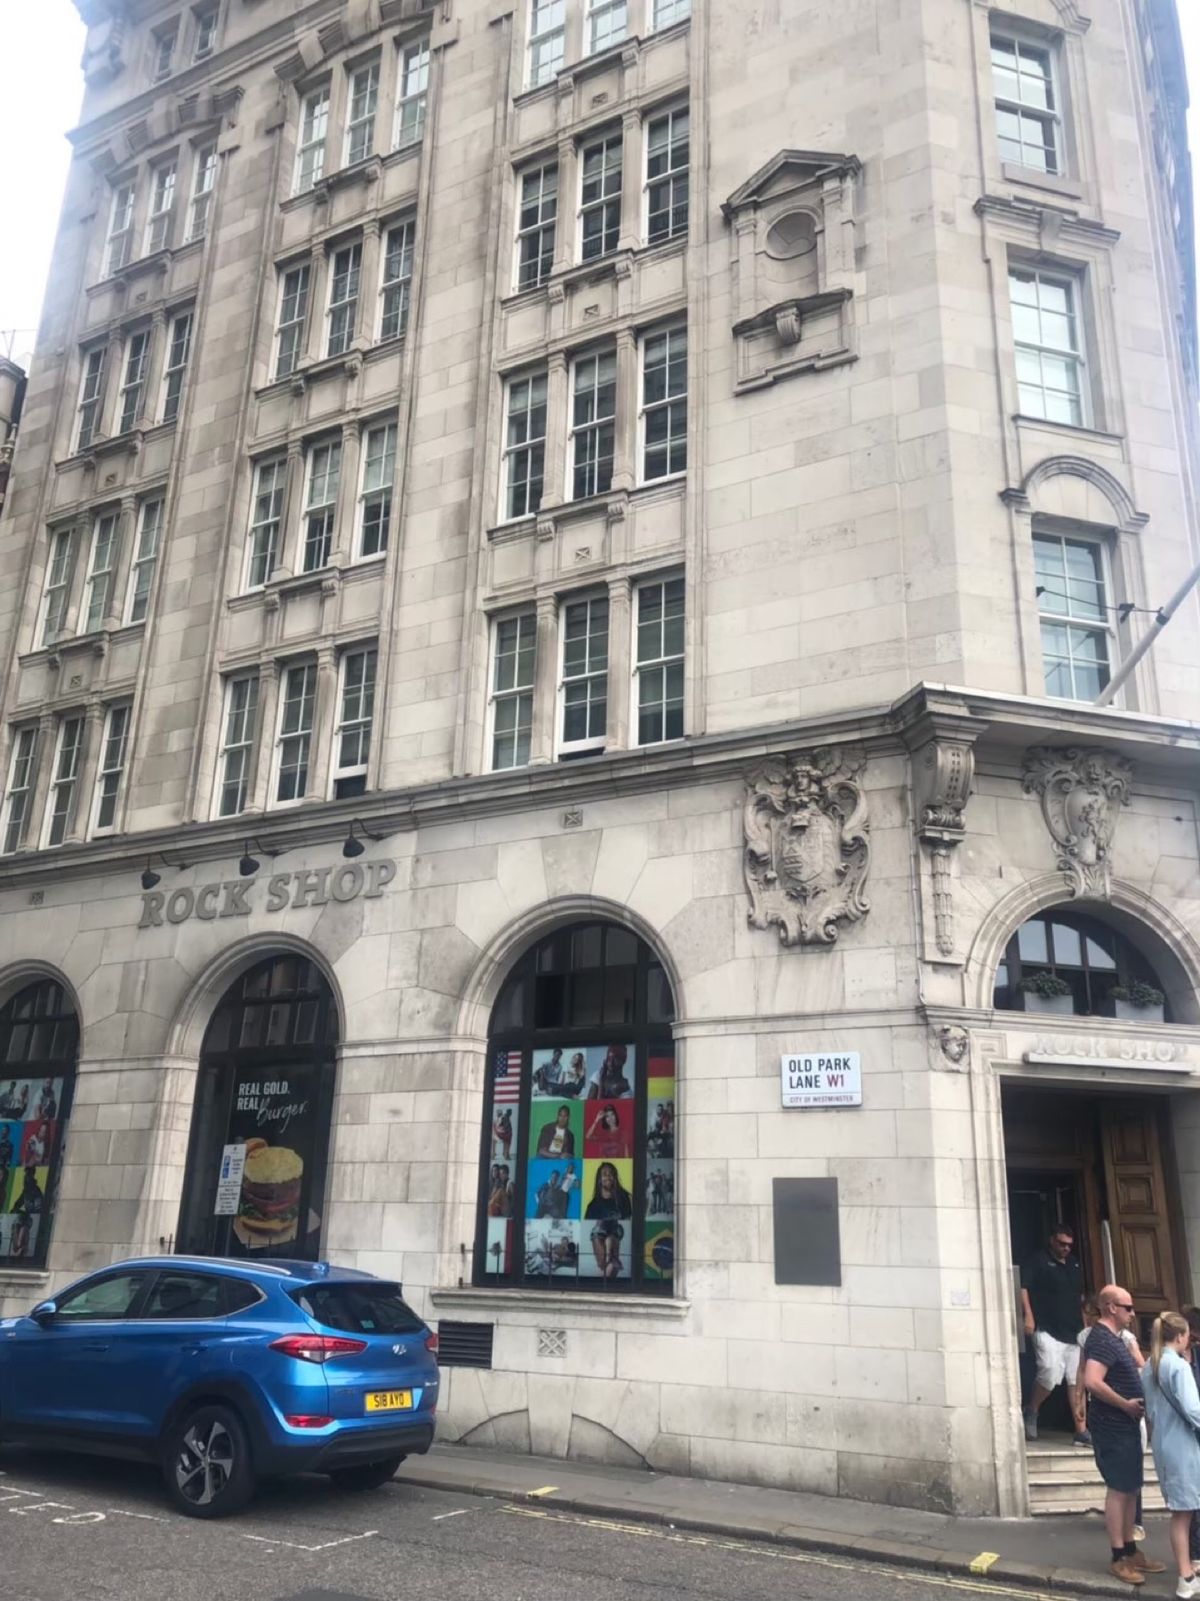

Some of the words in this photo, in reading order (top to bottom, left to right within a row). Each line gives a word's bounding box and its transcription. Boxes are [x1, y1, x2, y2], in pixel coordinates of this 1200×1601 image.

[138, 878, 255, 929] ROCK
[266, 858, 397, 913] SHOP
[788, 1059, 812, 1073] OLD
[818, 1057, 851, 1072] PARK
[239, 1083, 261, 1095] REAL
[263, 1081, 290, 1095] GOLD.
[789, 1075, 821, 1089] LANE
[827, 1073, 844, 1088] W1
[237, 1098, 259, 1111] REAL
